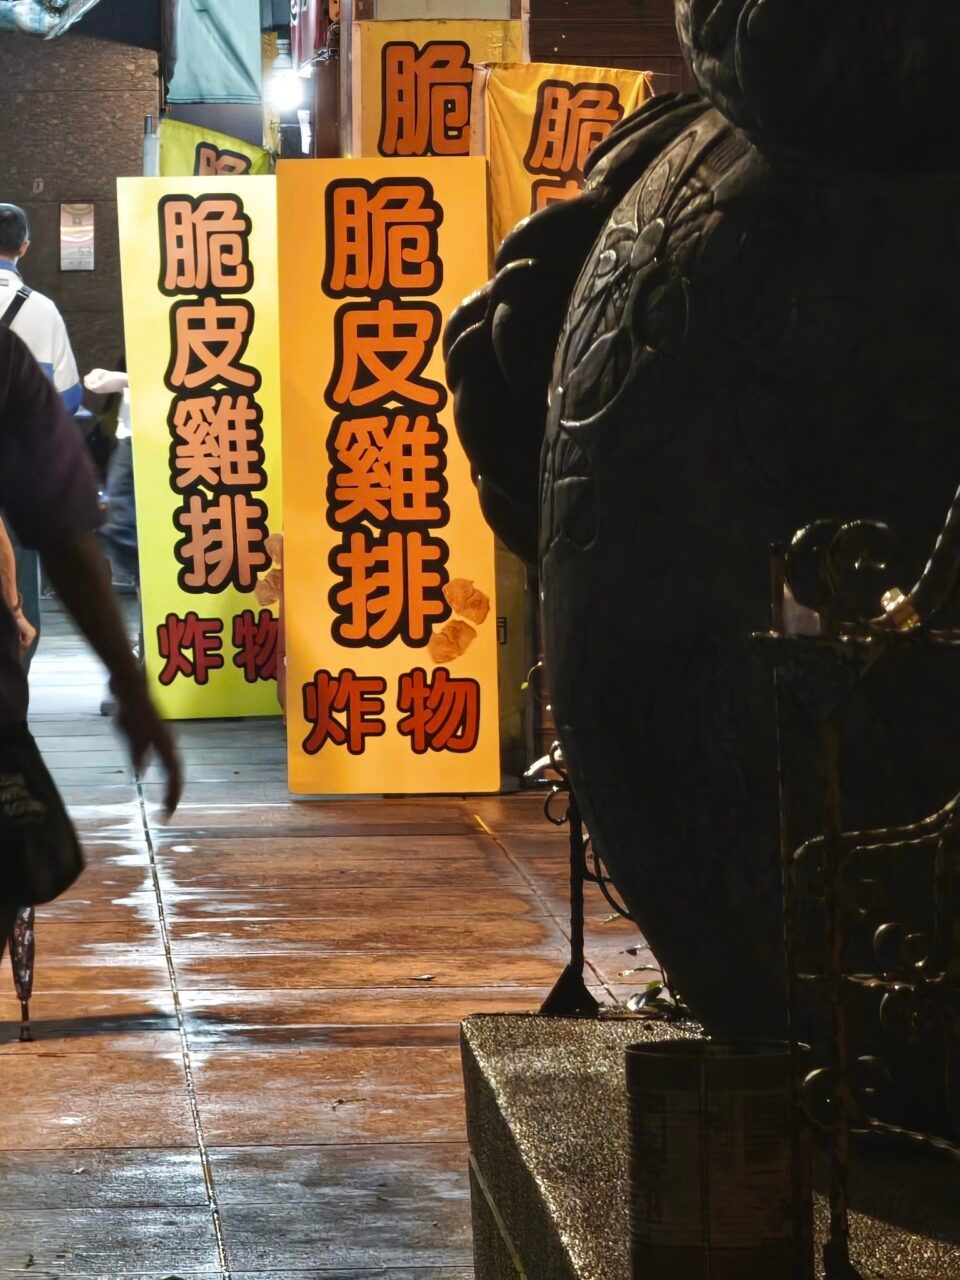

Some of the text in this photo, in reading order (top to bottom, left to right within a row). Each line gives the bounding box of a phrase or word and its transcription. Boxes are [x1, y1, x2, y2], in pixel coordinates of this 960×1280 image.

[377, 41, 474, 157] 脆
[157, 193, 276, 593] 脆皮雞排
[322, 177, 453, 649] 脆皮雞排
[157, 611, 285, 686] 炸物
[301, 667, 482, 755] 炸物
